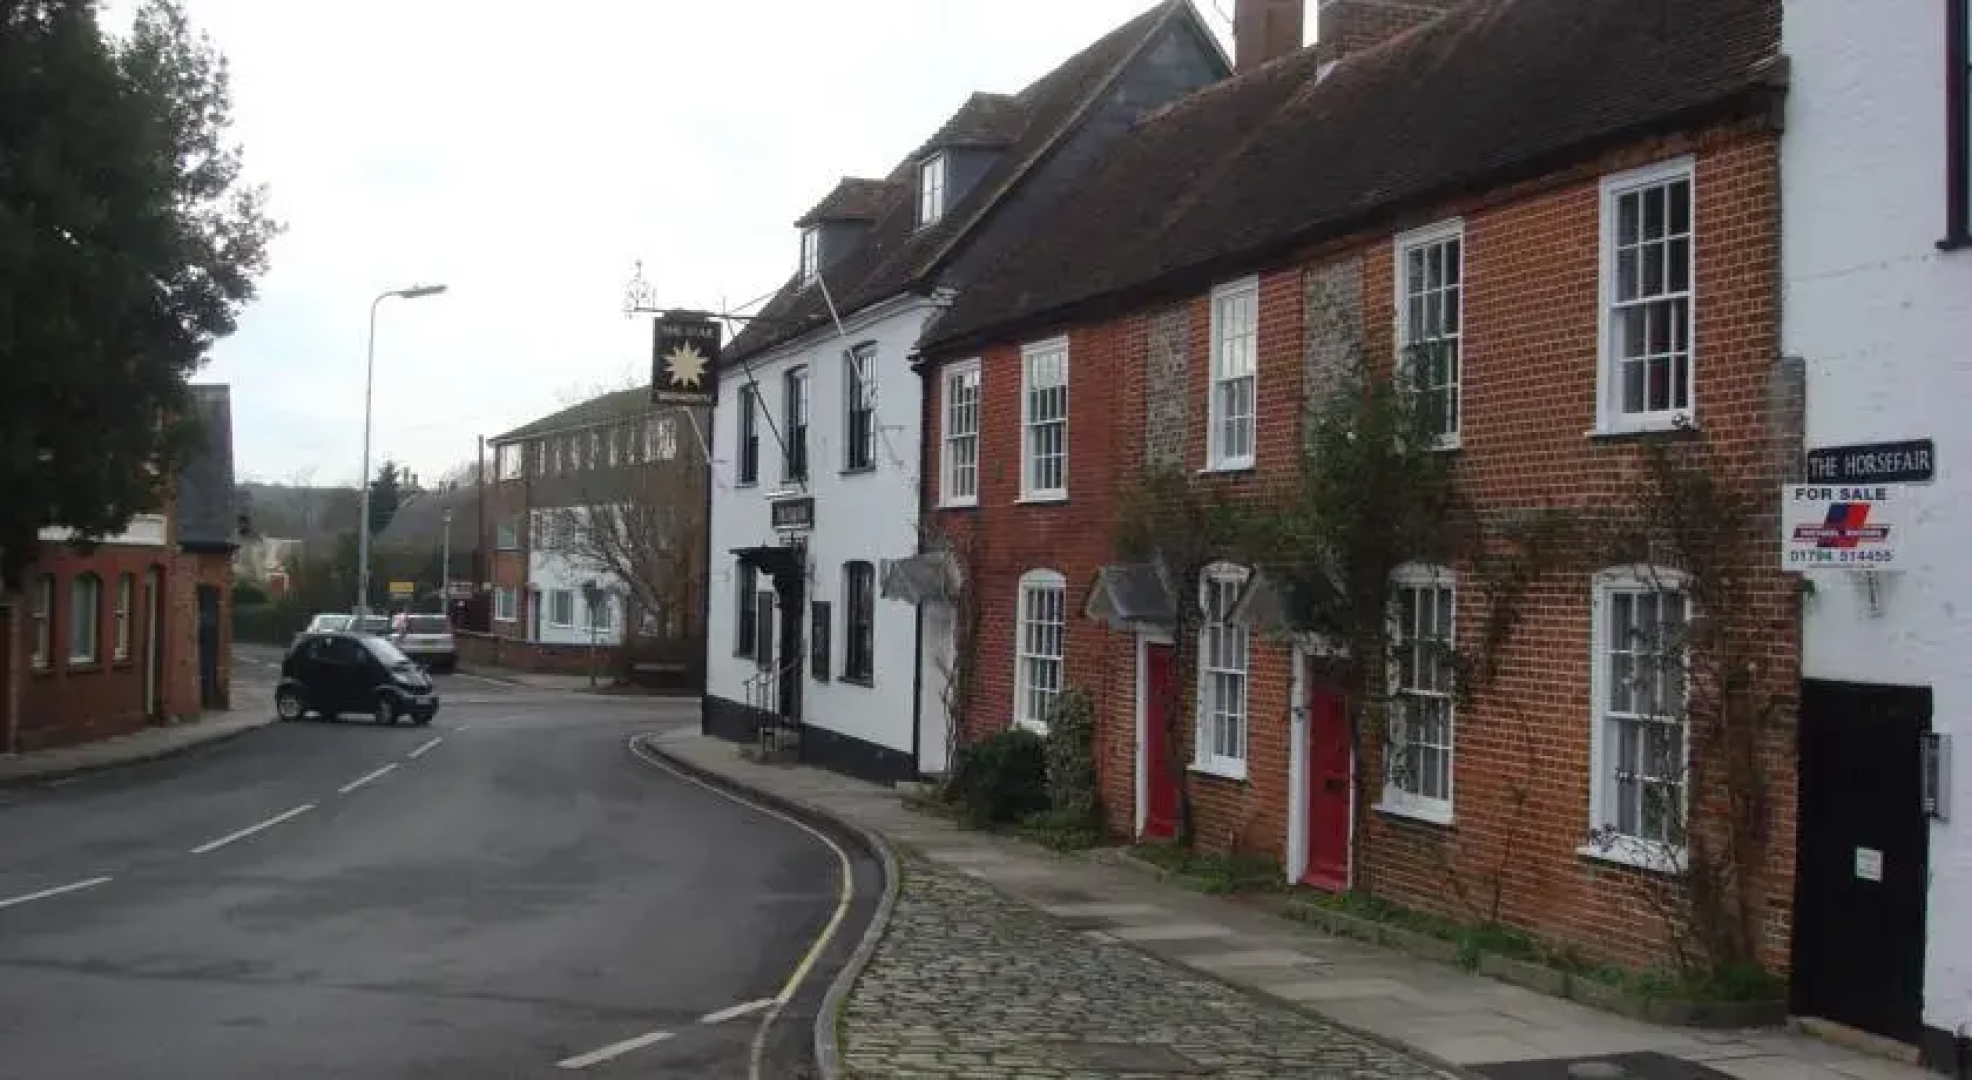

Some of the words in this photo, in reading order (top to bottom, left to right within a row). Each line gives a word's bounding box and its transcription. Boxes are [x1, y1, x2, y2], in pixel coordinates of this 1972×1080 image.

[1809, 455, 1838, 478] THE
[1844, 450, 1930, 475] HORSEFAIR
[1795, 487, 1832, 500] FOR
[1840, 487, 1887, 500] SALE
